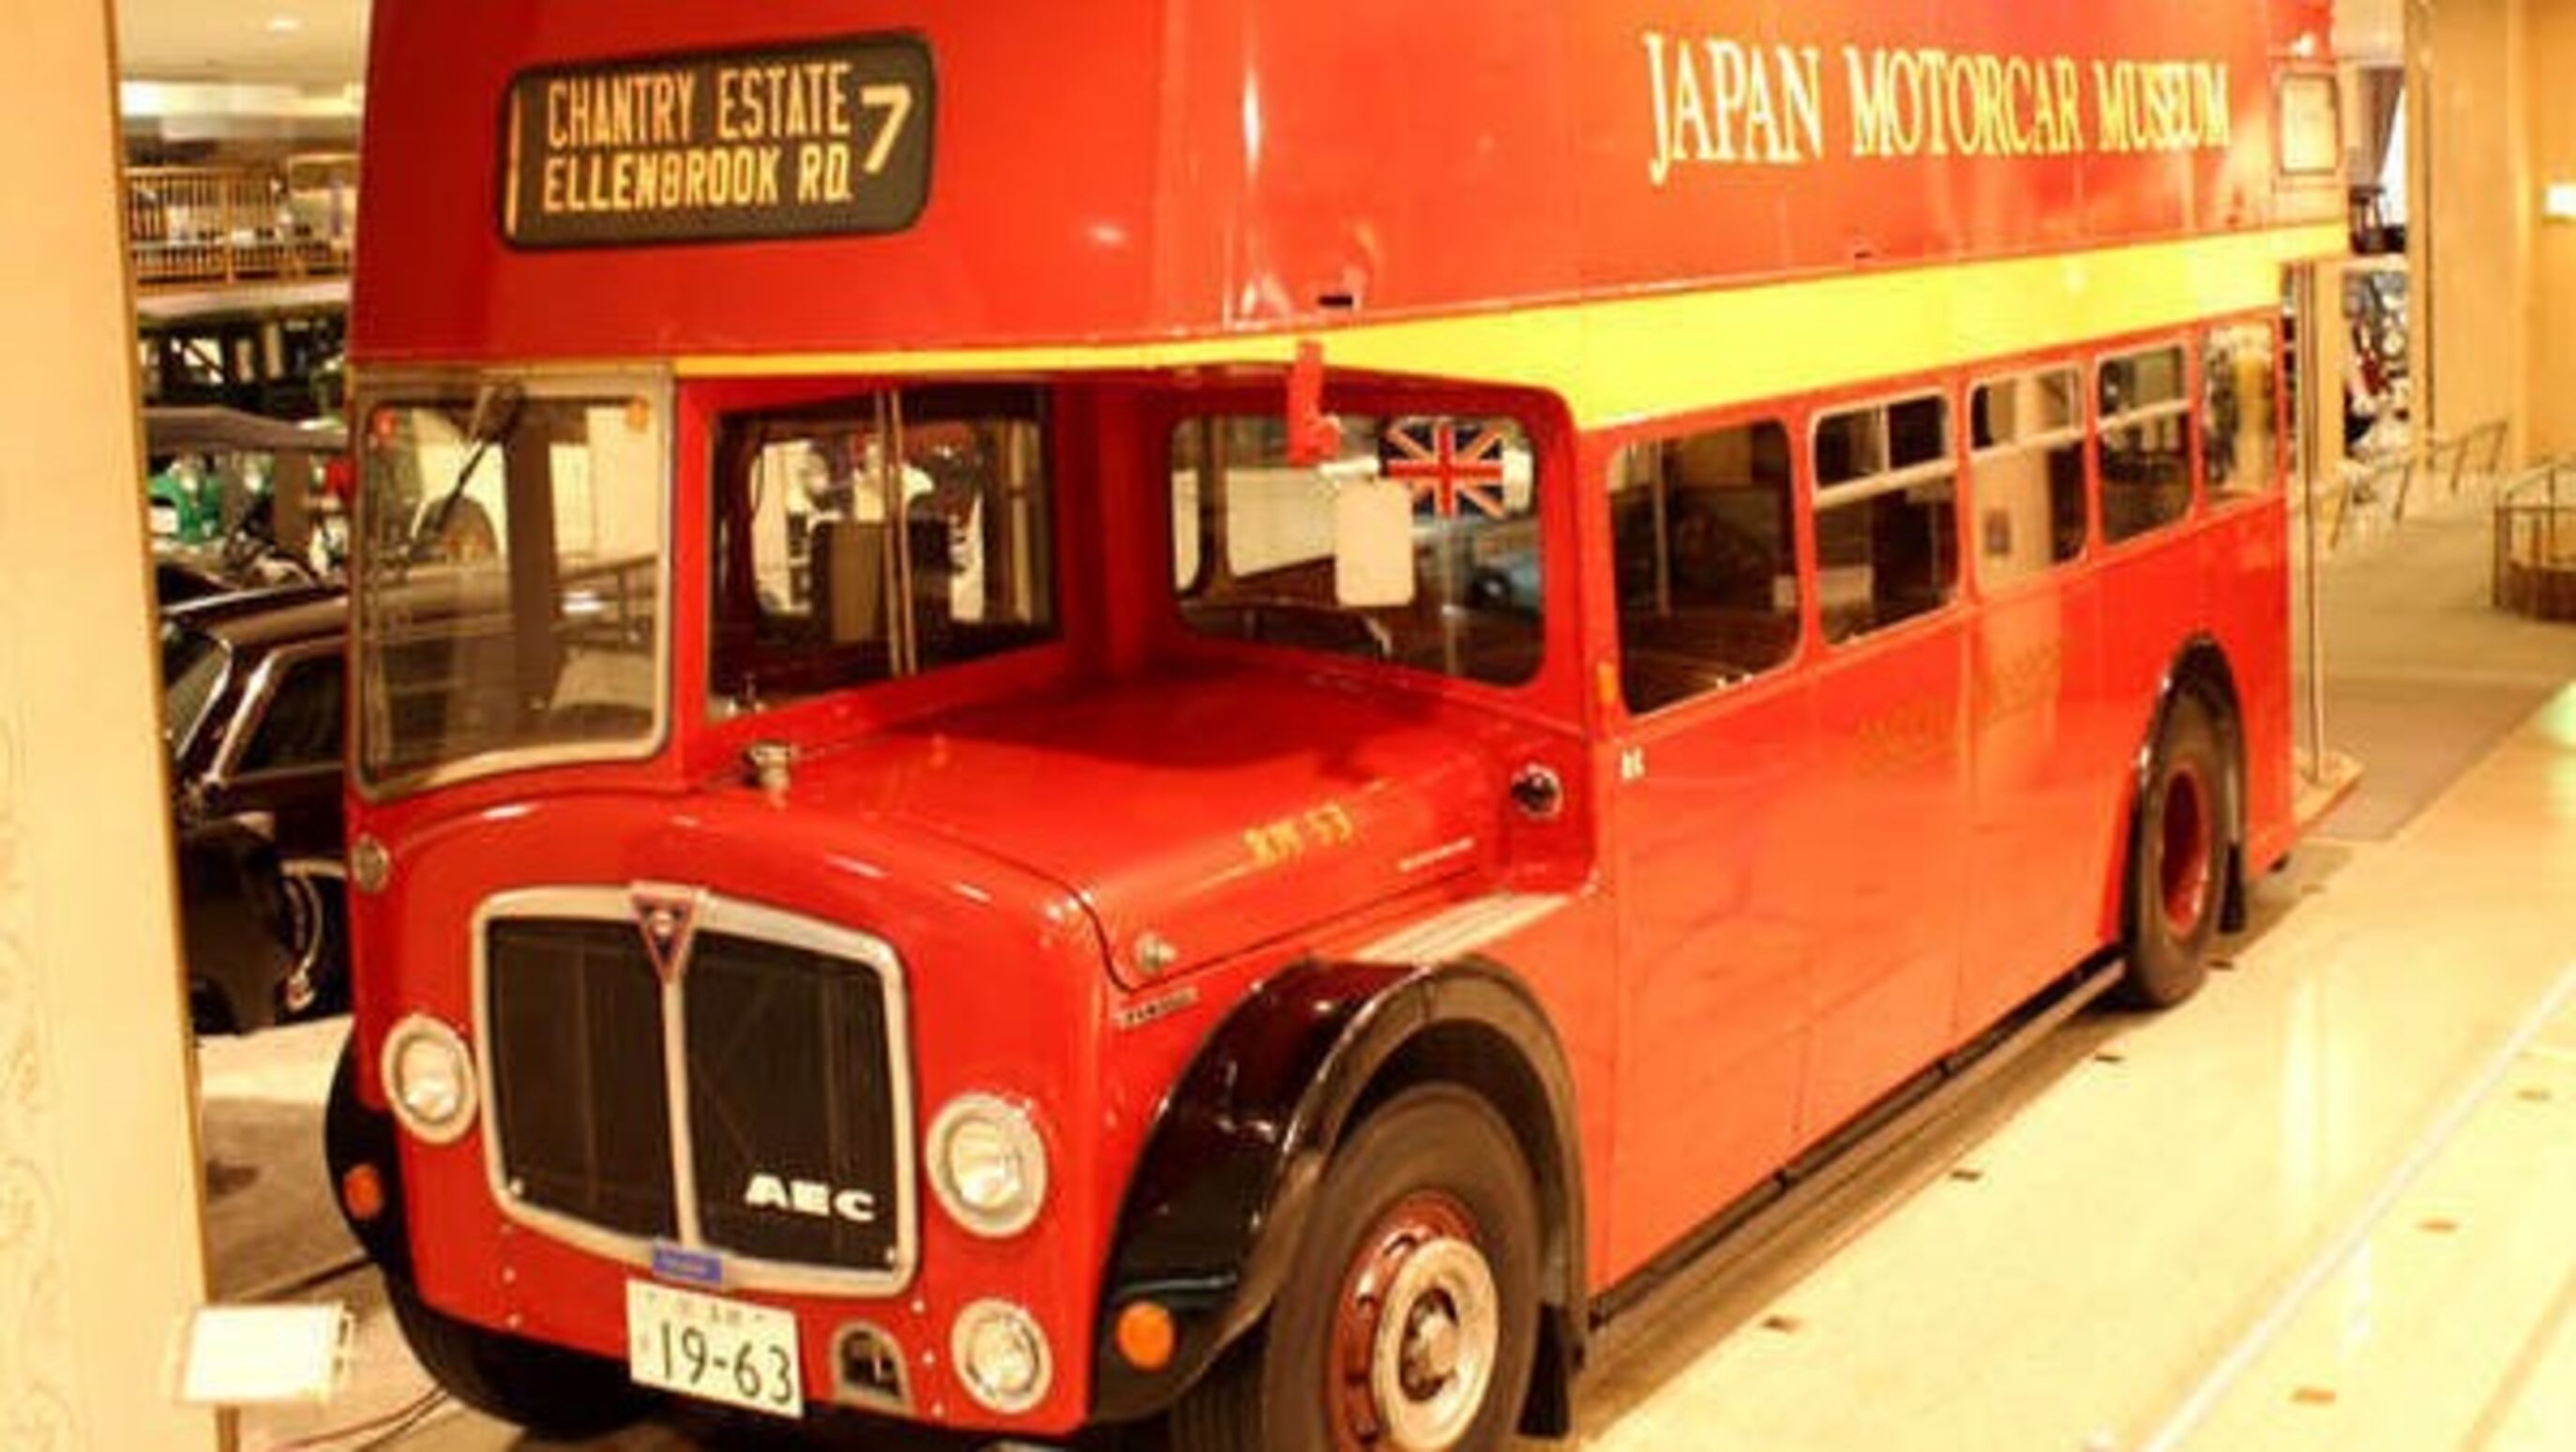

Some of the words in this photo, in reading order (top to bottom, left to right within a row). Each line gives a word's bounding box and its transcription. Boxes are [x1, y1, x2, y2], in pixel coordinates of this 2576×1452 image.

[548, 70, 695, 148] CHANTRY
[718, 62, 852, 138] ESTATE
[860, 83, 911, 174] 7
[1645, 33, 1822, 187] JAPAN
[1844, 45, 2084, 158] MOTORCAR
[2097, 61, 2231, 151] MUSEUM
[543, 147, 782, 212] ELLENBROOK
[744, 1173, 876, 1221] AEC
[660, 1319, 793, 1406] 19-63
